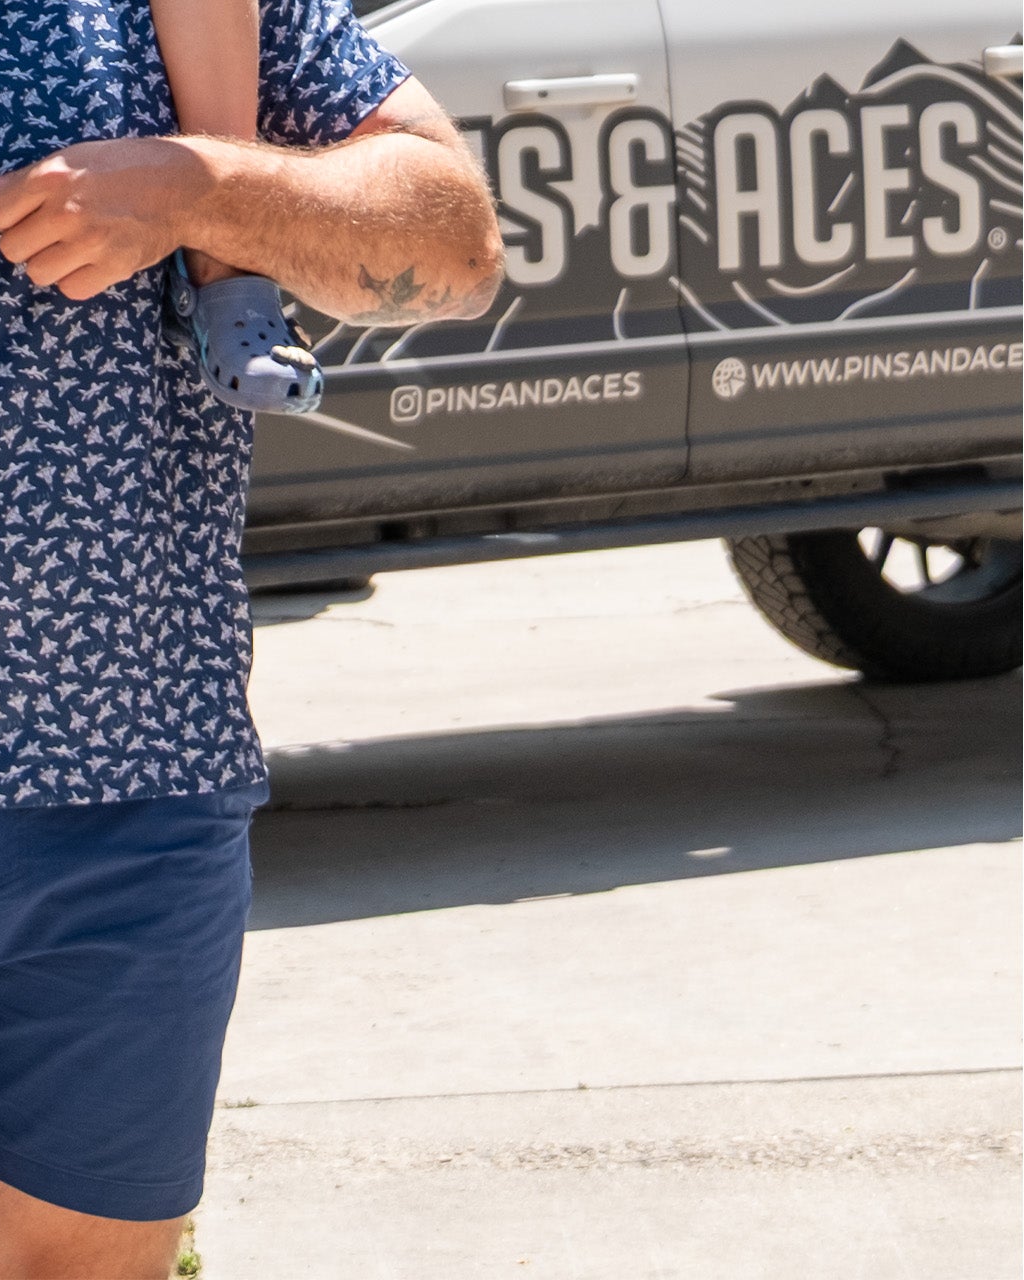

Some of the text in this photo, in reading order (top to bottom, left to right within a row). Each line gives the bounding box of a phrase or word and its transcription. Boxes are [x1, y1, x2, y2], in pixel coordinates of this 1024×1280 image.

[461, 124, 564, 285] S
[608, 119, 677, 276] &
[426, 371, 641, 413] PINSANDACES
